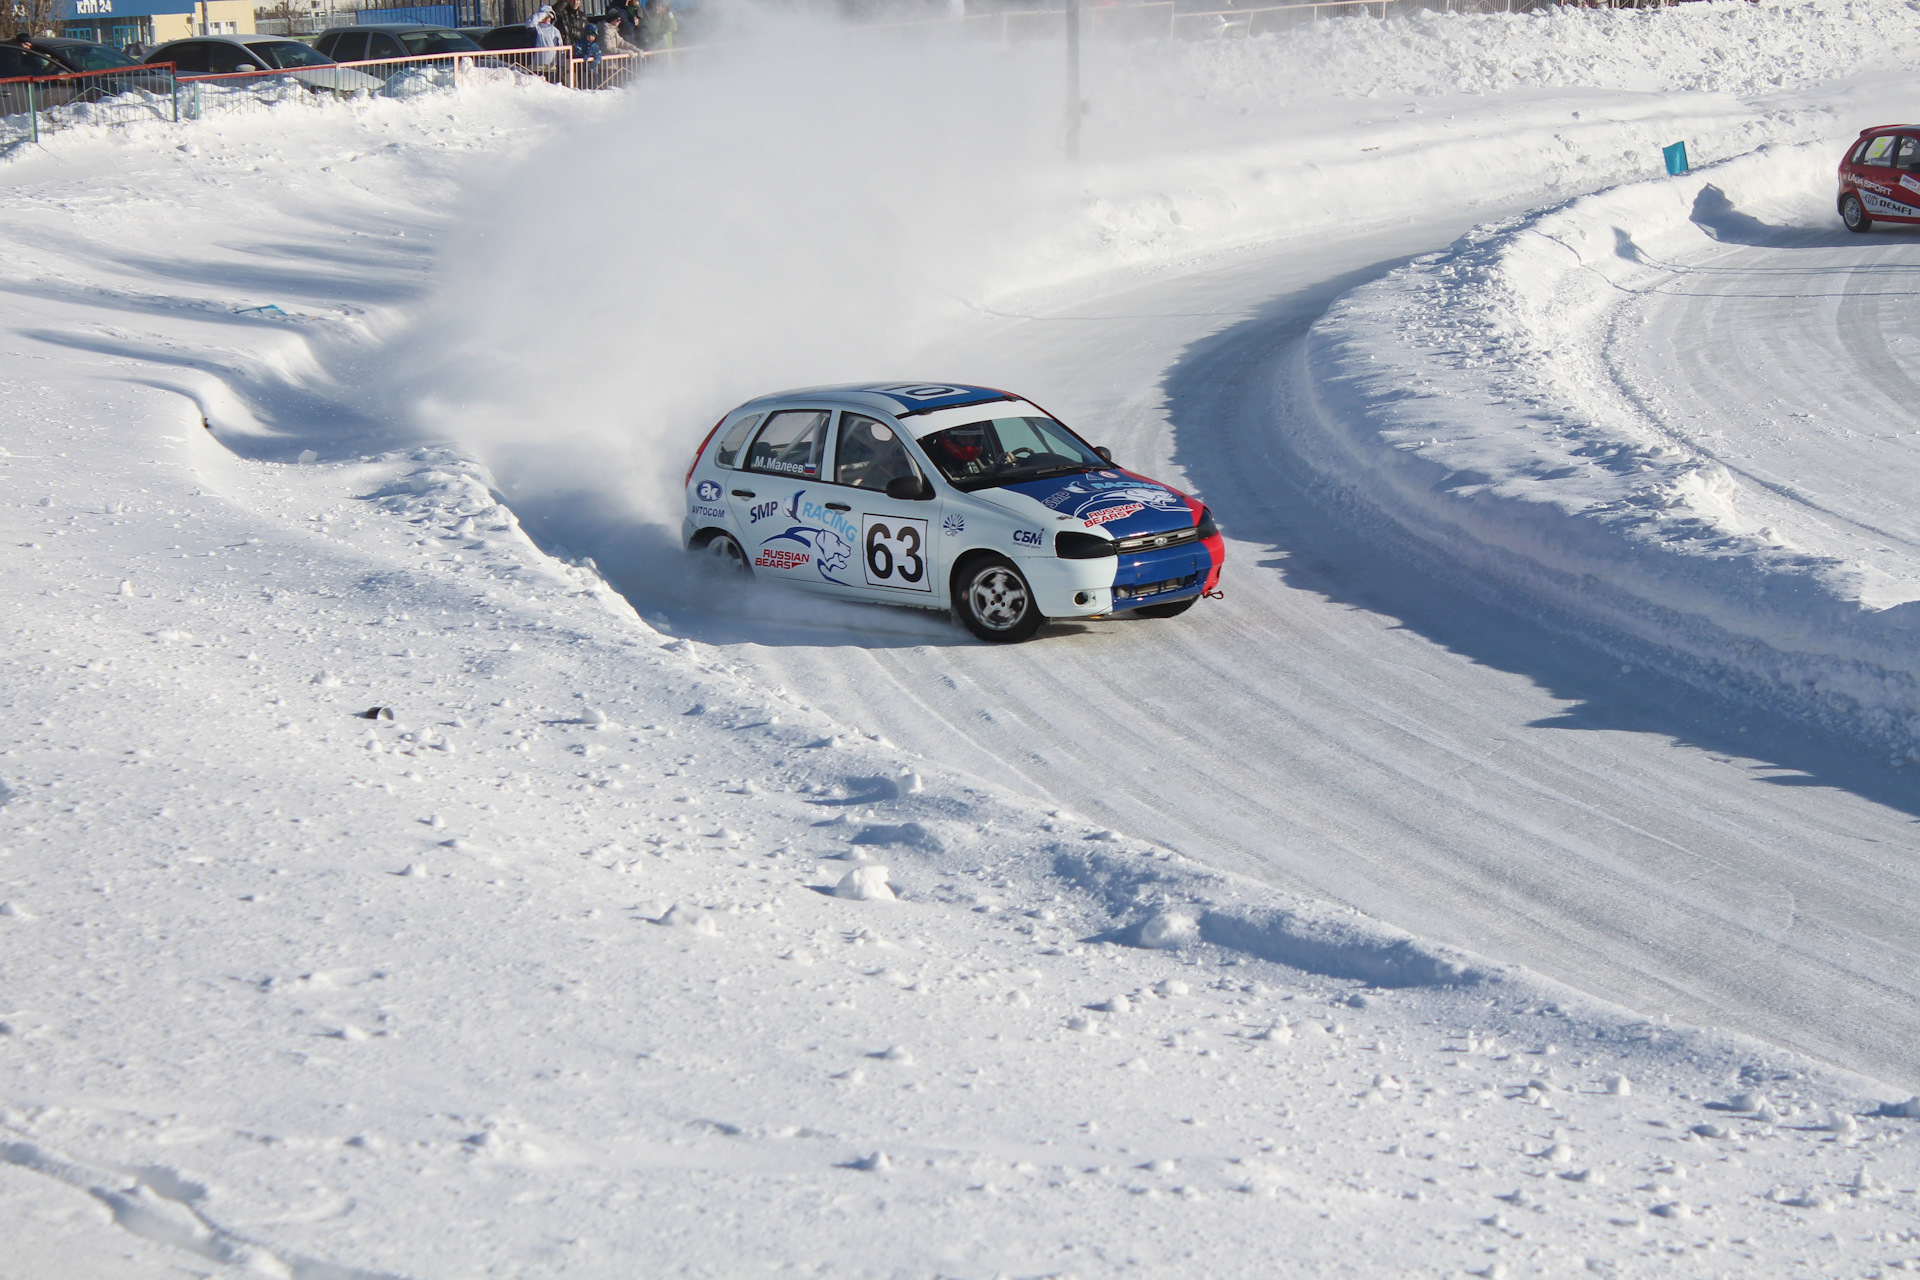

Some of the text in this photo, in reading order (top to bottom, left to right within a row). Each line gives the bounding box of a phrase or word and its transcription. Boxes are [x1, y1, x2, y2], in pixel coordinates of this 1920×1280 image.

[99, 0, 112, 13] 24
[1873, 138, 1887, 157] 5
[1864, 180, 1892, 195] SPORT
[1880, 200, 1912, 216] DEMFI
[755, 456, 804, 474] М.Малеев
[1090, 481, 1167, 491] RACING
[692, 505, 725, 519] AVTOCOM
[1087, 502, 1144, 518] RUSSIAN
[750, 501, 858, 543] SMP RACING
[1084, 512, 1127, 528] BEARS
[1013, 528, 1044, 545] СБМ
[762, 549, 810, 562] RUSSIAN
[866, 523, 924, 583] 63
[755, 557, 791, 569] BEARS
